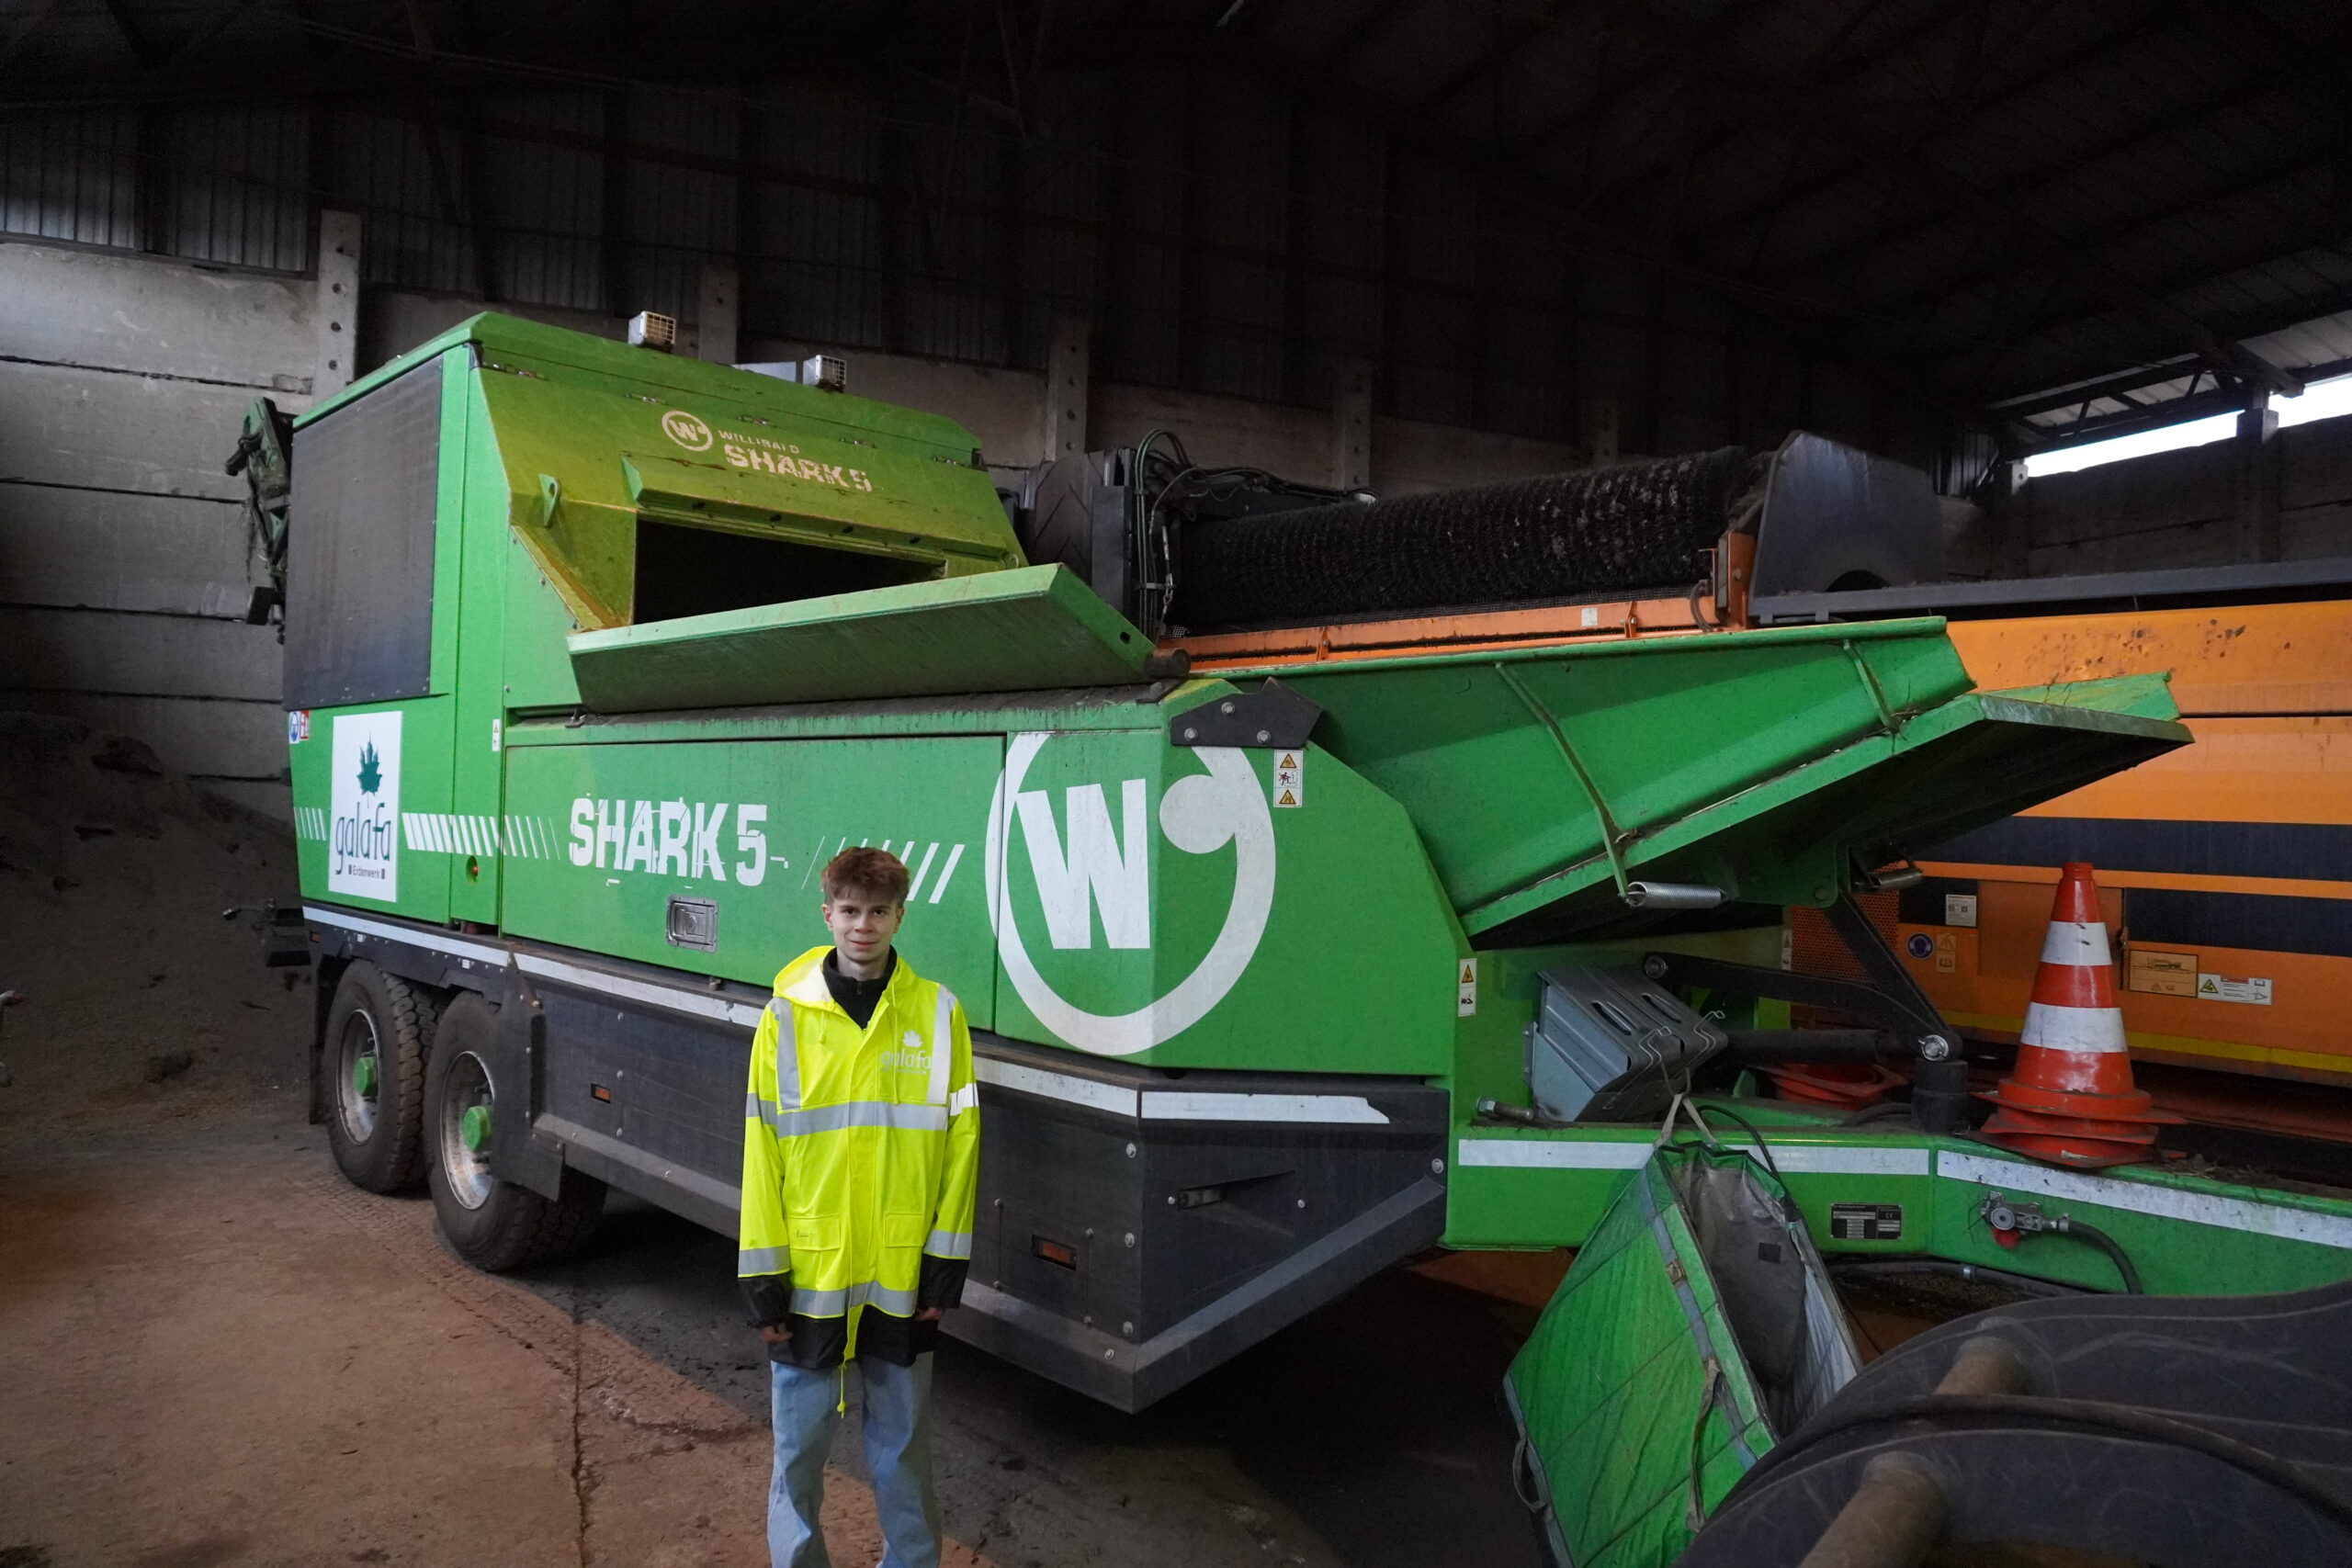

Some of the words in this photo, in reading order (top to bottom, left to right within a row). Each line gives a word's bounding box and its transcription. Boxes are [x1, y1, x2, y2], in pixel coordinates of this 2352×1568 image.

[724, 444, 850, 488] SHARK
[849, 468, 872, 492] 5
[335, 802, 391, 874] galafa
[569, 797, 729, 882] SHARK
[736, 804, 767, 886] 5
[1014, 778, 1150, 950] W
[880, 1048, 933, 1072] galafa
